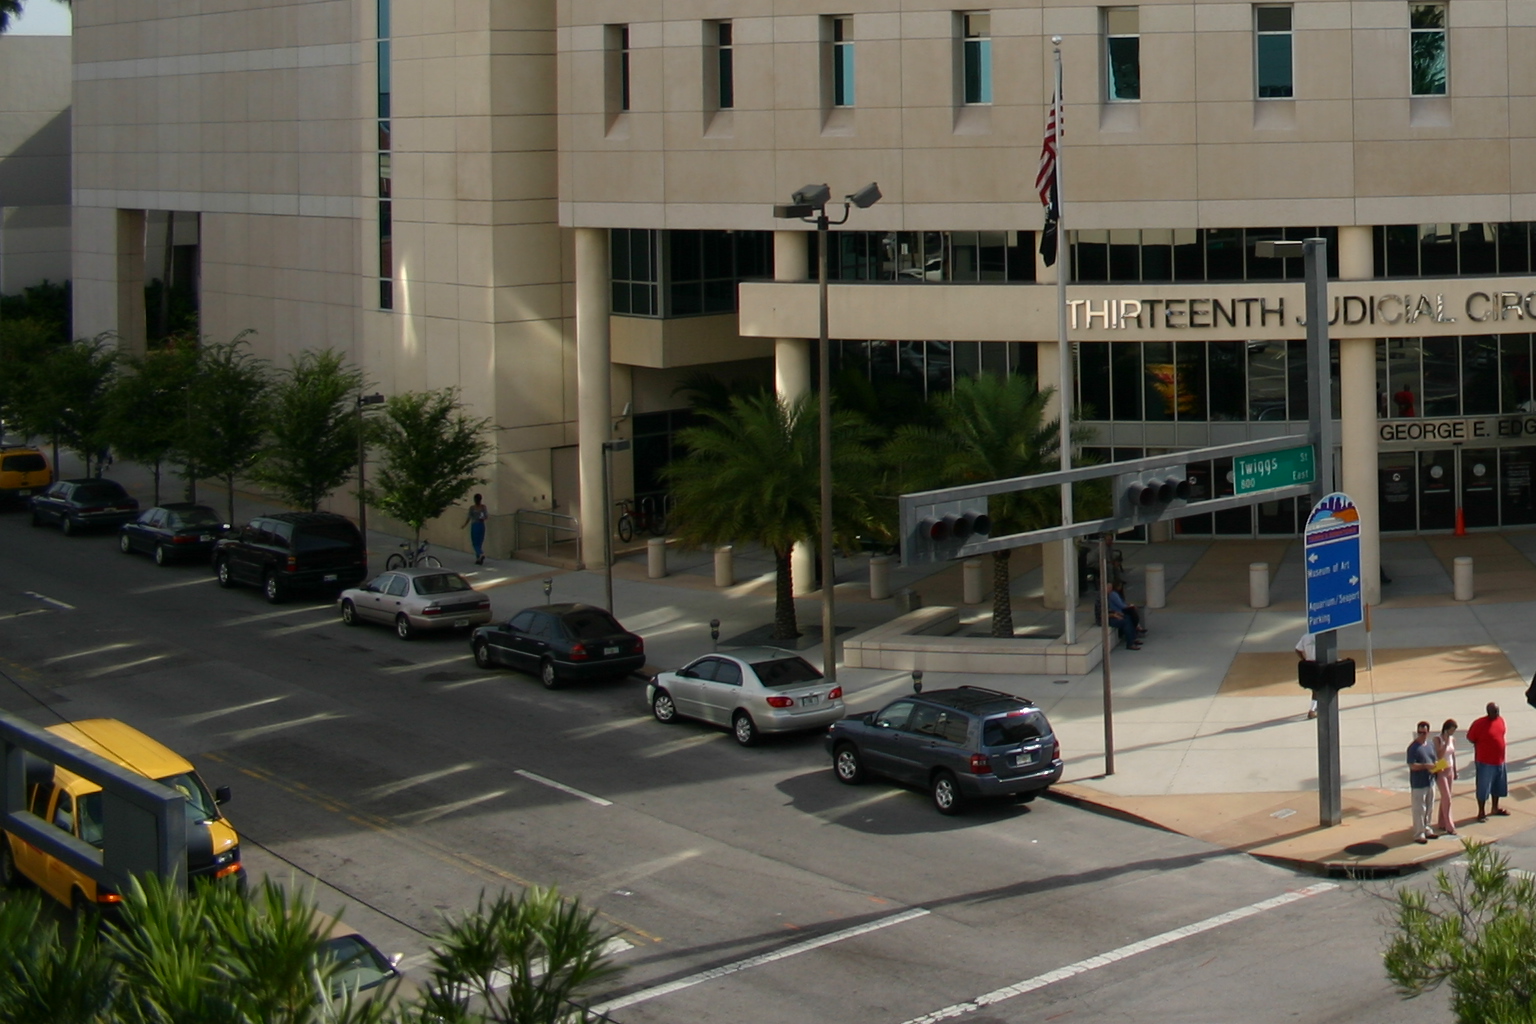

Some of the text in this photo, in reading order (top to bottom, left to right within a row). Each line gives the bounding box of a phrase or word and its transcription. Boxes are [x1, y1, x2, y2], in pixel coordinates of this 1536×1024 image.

[1065, 297, 1285, 330] THIRTEENTH
[1379, 421, 1465, 441] GEORGE
[1473, 420, 1490, 438] E.
[1239, 452, 1308, 477] Twiggs St
[1240, 469, 1309, 489] 800 East
[1308, 561, 1350, 578] Museum of Art
[1309, 613, 1331, 626] Parking
